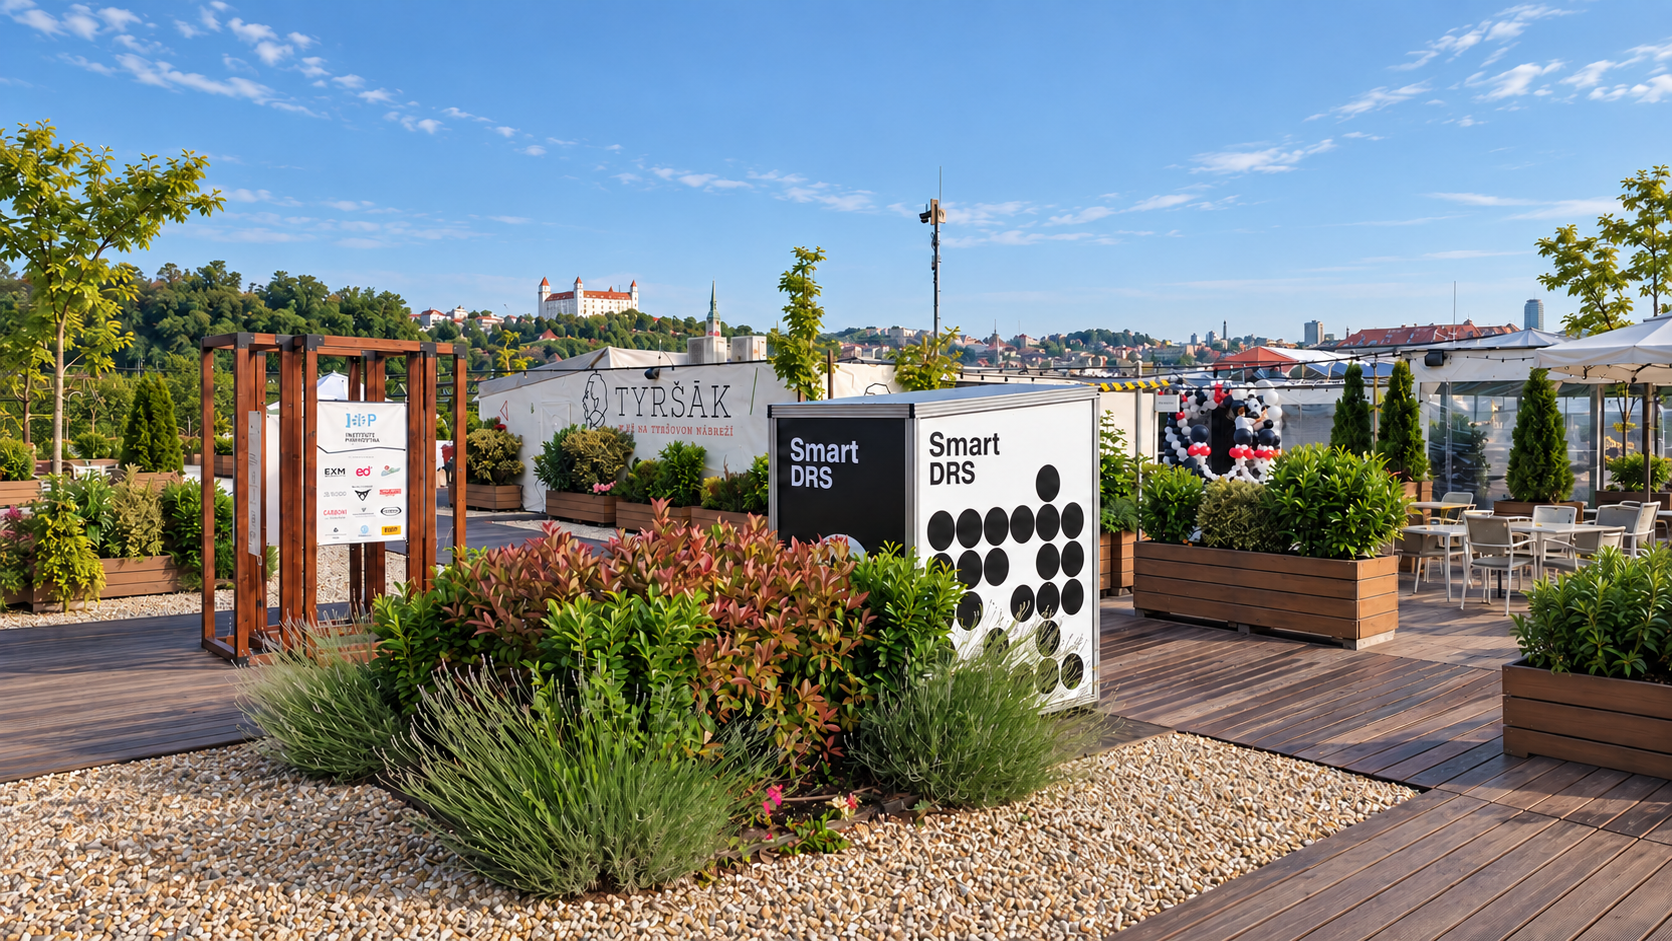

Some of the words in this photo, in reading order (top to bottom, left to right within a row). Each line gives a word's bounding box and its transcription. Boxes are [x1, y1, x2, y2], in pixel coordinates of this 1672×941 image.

[790, 437, 859, 464] Smart
[929, 431, 1000, 457] Smart
[790, 465, 833, 490] DRS
[929, 461, 976, 486] DRS
